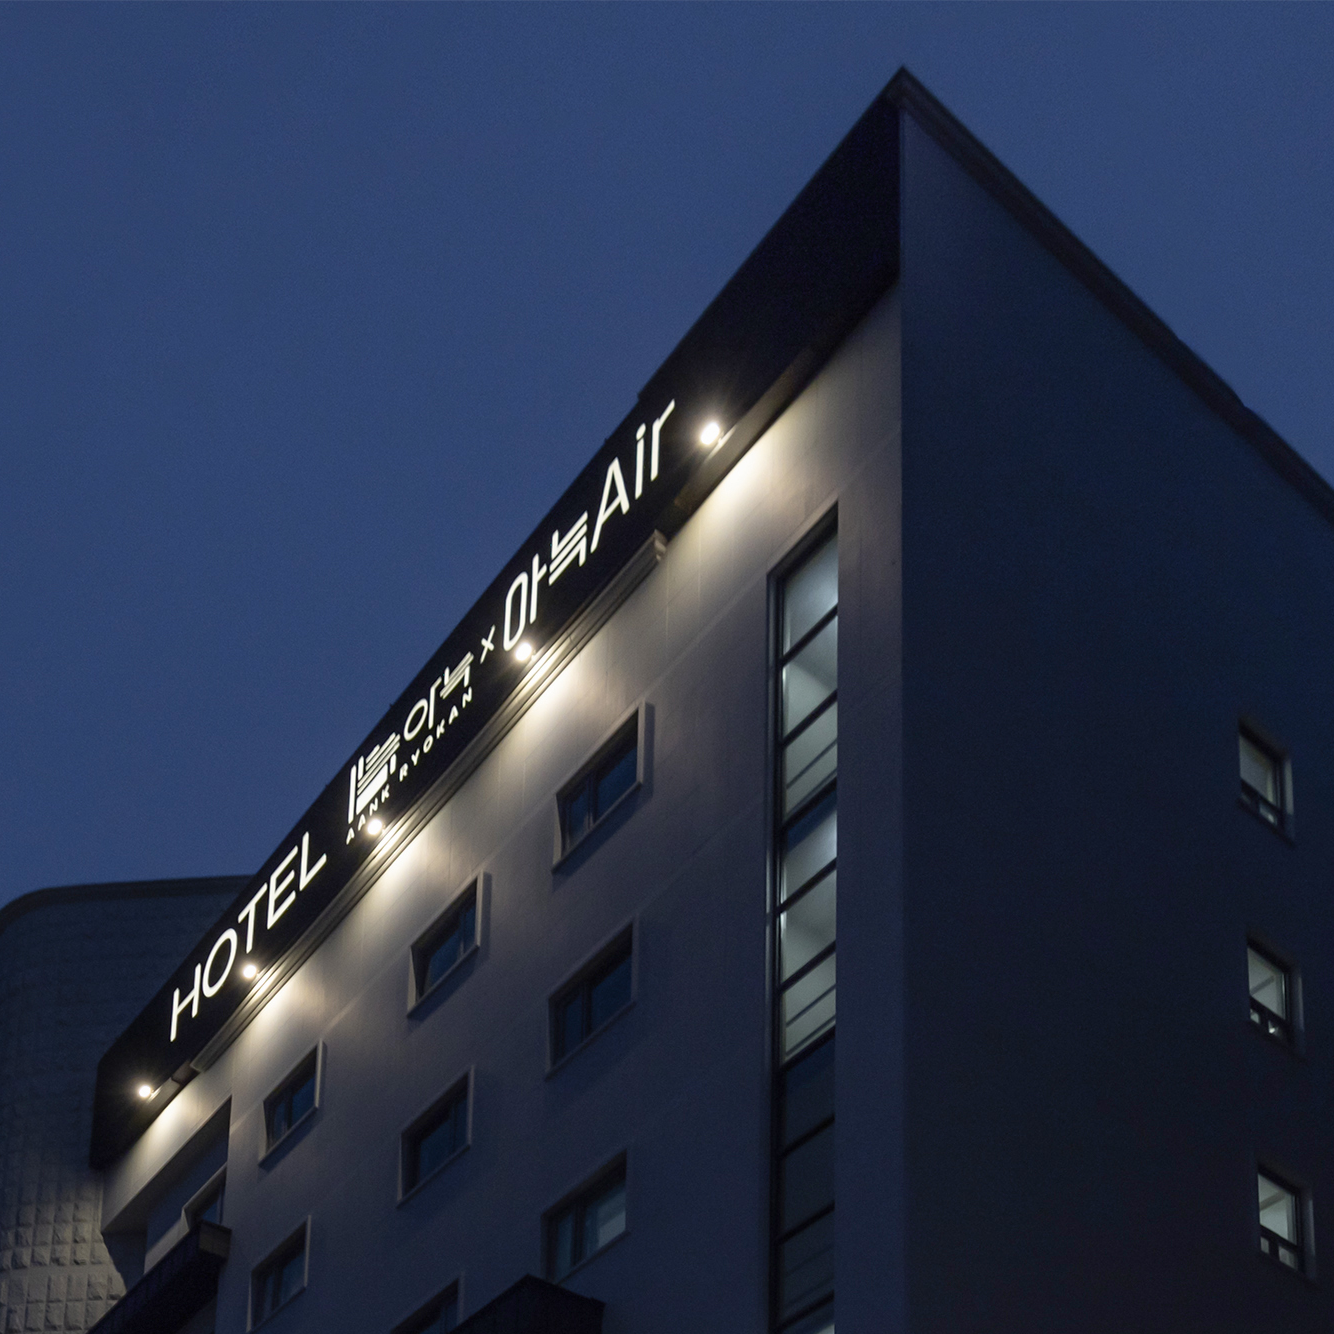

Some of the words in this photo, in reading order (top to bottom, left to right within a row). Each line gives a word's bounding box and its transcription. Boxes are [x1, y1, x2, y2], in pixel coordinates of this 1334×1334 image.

[346, 784, 390, 845] AANK
[398, 686, 473, 782] RYOKAN
[170, 831, 327, 1042] HOTEL
